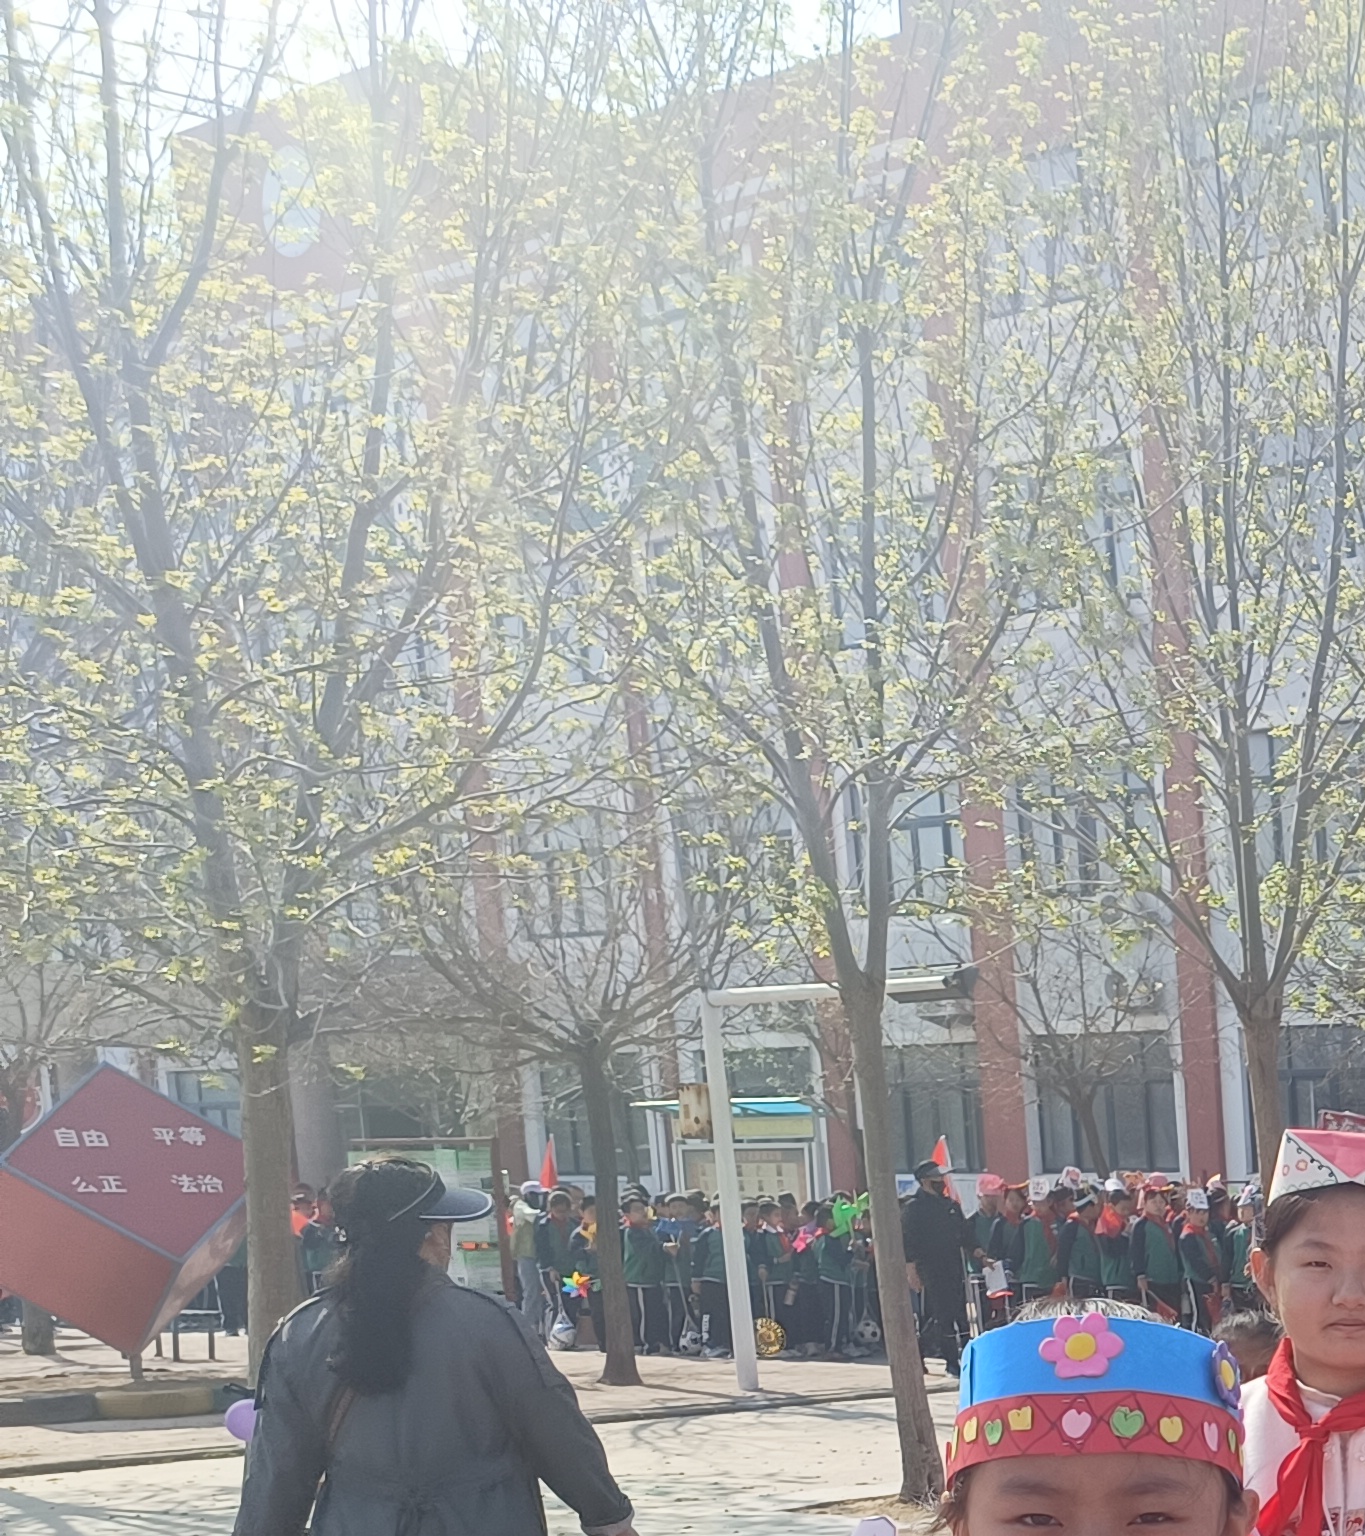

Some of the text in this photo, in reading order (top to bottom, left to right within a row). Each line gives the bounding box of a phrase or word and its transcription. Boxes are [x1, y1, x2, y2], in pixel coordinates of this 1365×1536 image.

[53, 1125, 206, 1147] 自由 平等
[71, 1173, 224, 1194] 公正 法治
